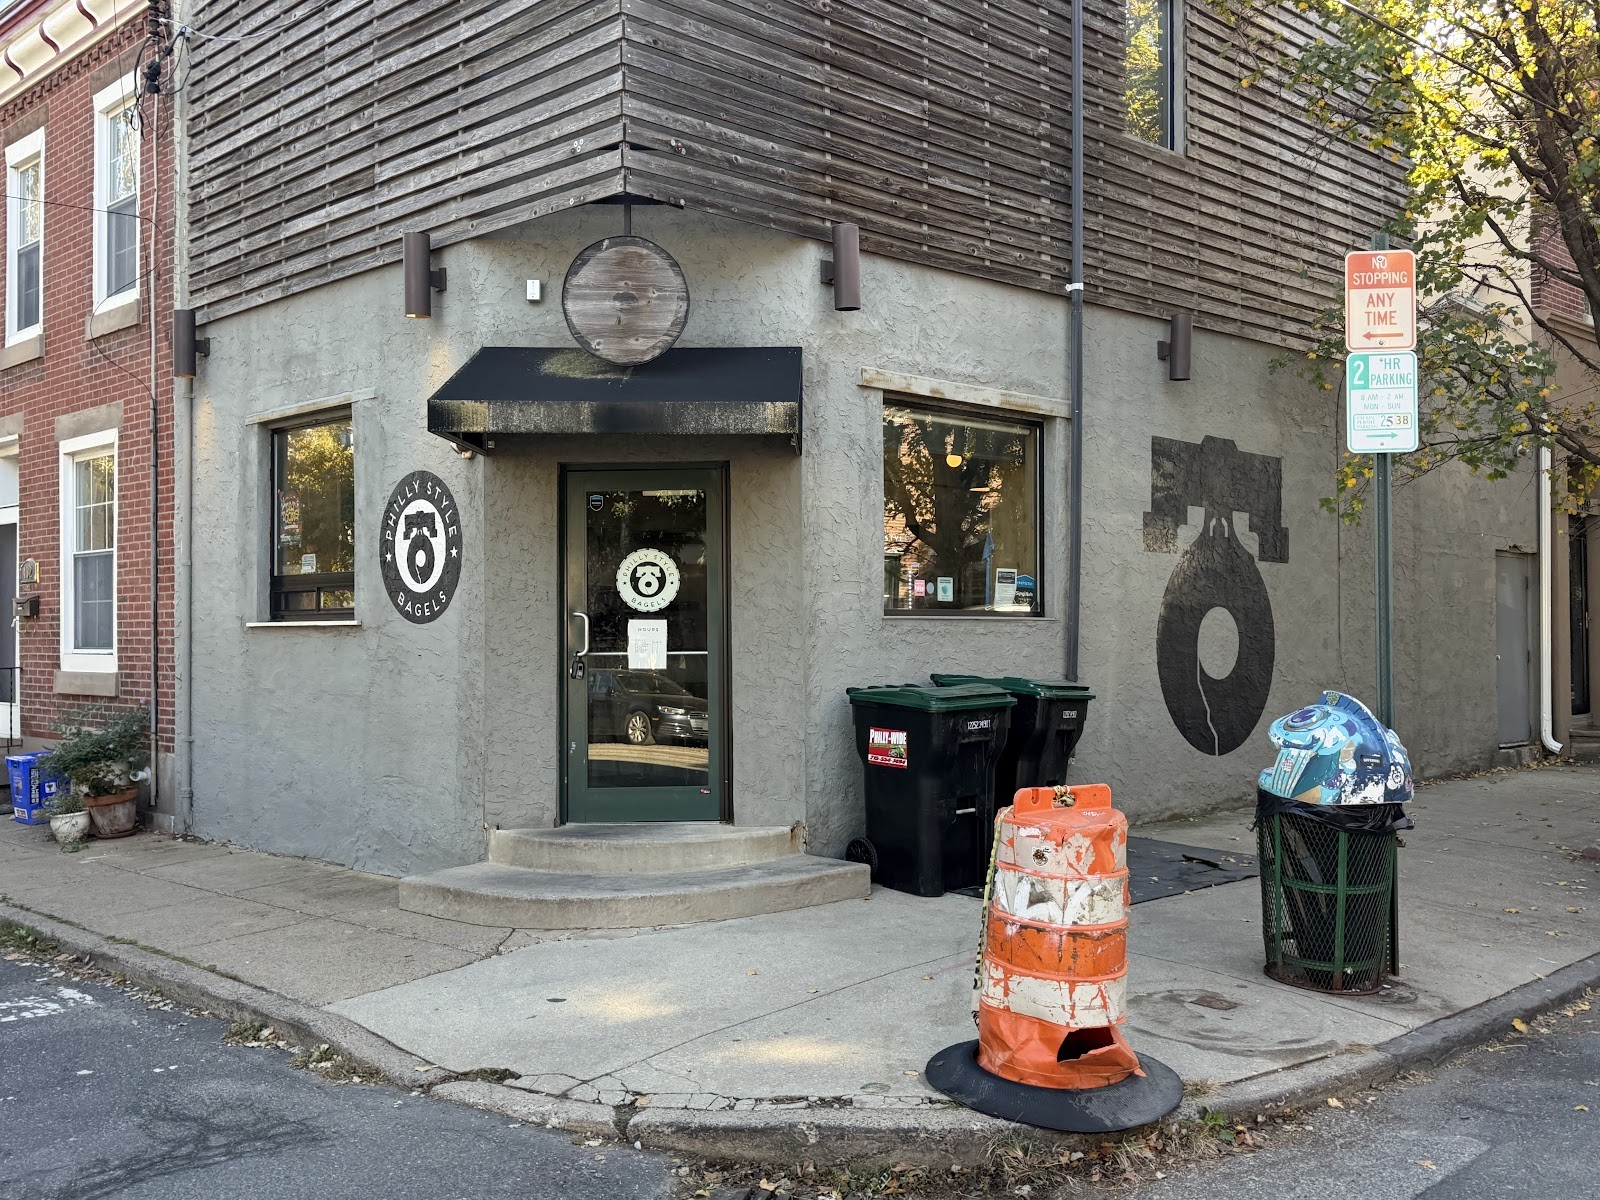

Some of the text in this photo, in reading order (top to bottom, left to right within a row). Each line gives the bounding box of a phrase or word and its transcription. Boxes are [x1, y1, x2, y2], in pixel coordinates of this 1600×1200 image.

[1372, 256, 1388, 269] NO
[1352, 271, 1408, 286] STOPPING
[1366, 292, 1395, 308] ANY
[1365, 310, 1397, 326] TIME
[1384, 357, 1401, 370] HR
[1353, 360, 1365, 385] 2
[1370, 372, 1412, 386] PARKING
[1367, 393, 1378, 401] AM
[1387, 402, 1401, 410] SUN
[385, 480, 457, 541] PHILLY STYLE
[623, 553, 675, 577] PHILLY STYLE
[397, 591, 446, 616] BAGELS
[631, 597, 666, 608] BAGELS
[869, 729, 907, 745] PHILLY-WIDE
